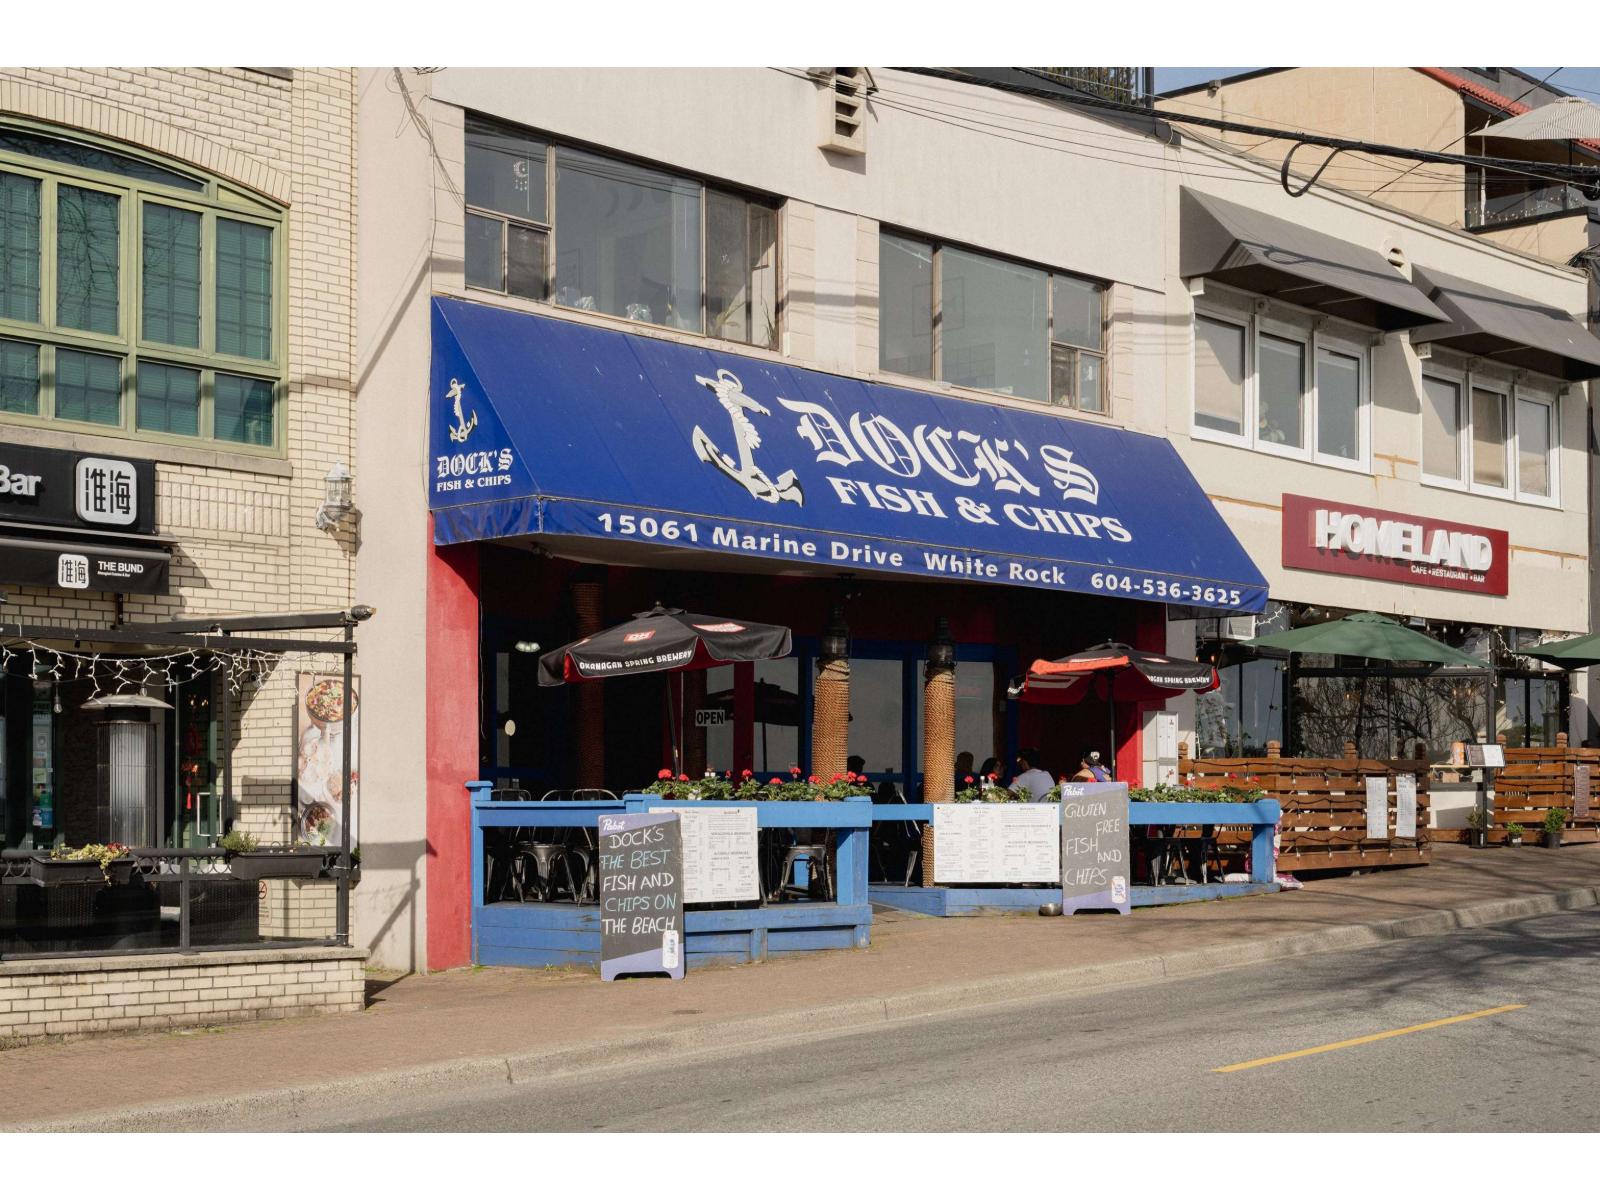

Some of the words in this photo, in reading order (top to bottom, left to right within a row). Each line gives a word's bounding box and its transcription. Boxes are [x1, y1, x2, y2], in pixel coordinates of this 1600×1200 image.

[777, 396, 1100, 505] DOCK'S
[436, 448, 514, 478] DOCK'S
[436, 480, 462, 492] FISH
[464, 479, 474, 489] &
[477, 474, 512, 488] CHIPS
[826, 476, 949, 519] FISH
[955, 496, 1000, 526] &
[1003, 503, 1134, 543] CHIPS
[1313, 509, 1493, 571] HOMELAND
[98, 560, 116, 572] THE
[118, 563, 144, 574] BUND
[598, 513, 698, 542] 15061
[712, 526, 817, 557] Marine
[830, 541, 904, 567] Drive
[923, 552, 998, 578] White
[1009, 562, 1066, 585] Rock
[1091, 572, 1241, 605] 604-536-3625
[1410, 565, 1428, 575] CAFE
[1432, 568, 1468, 580] RESTAURANT
[1473, 574, 1485, 583] BAR
[579, 660, 622, 670] OKANAGAN
[624, 657, 654, 668] SPRING
[656, 650, 692, 664] BREWERY
[1164, 676, 1184, 684] SPRING
[1184, 676, 1210, 684] BREWERY
[696, 711, 724, 725] OPEN
[1064, 785, 1084, 796] Pabst
[1064, 802, 1106, 818] GLUTEN
[1096, 818, 1120, 836] FREE
[609, 826, 665, 849] DOCK'S
[1066, 837, 1098, 856] FISH
[600, 854, 625, 870] THE
[630, 850, 672, 870] BEST
[1098, 850, 1122, 864] AND
[603, 874, 636, 892] FISH
[640, 872, 674, 890] AND
[1064, 868, 1109, 886] CHIPS
[605, 896, 650, 912] CHIPS
[654, 892, 677, 910] ON
[602, 918, 627, 936] THE
[632, 916, 676, 935] BEACH
